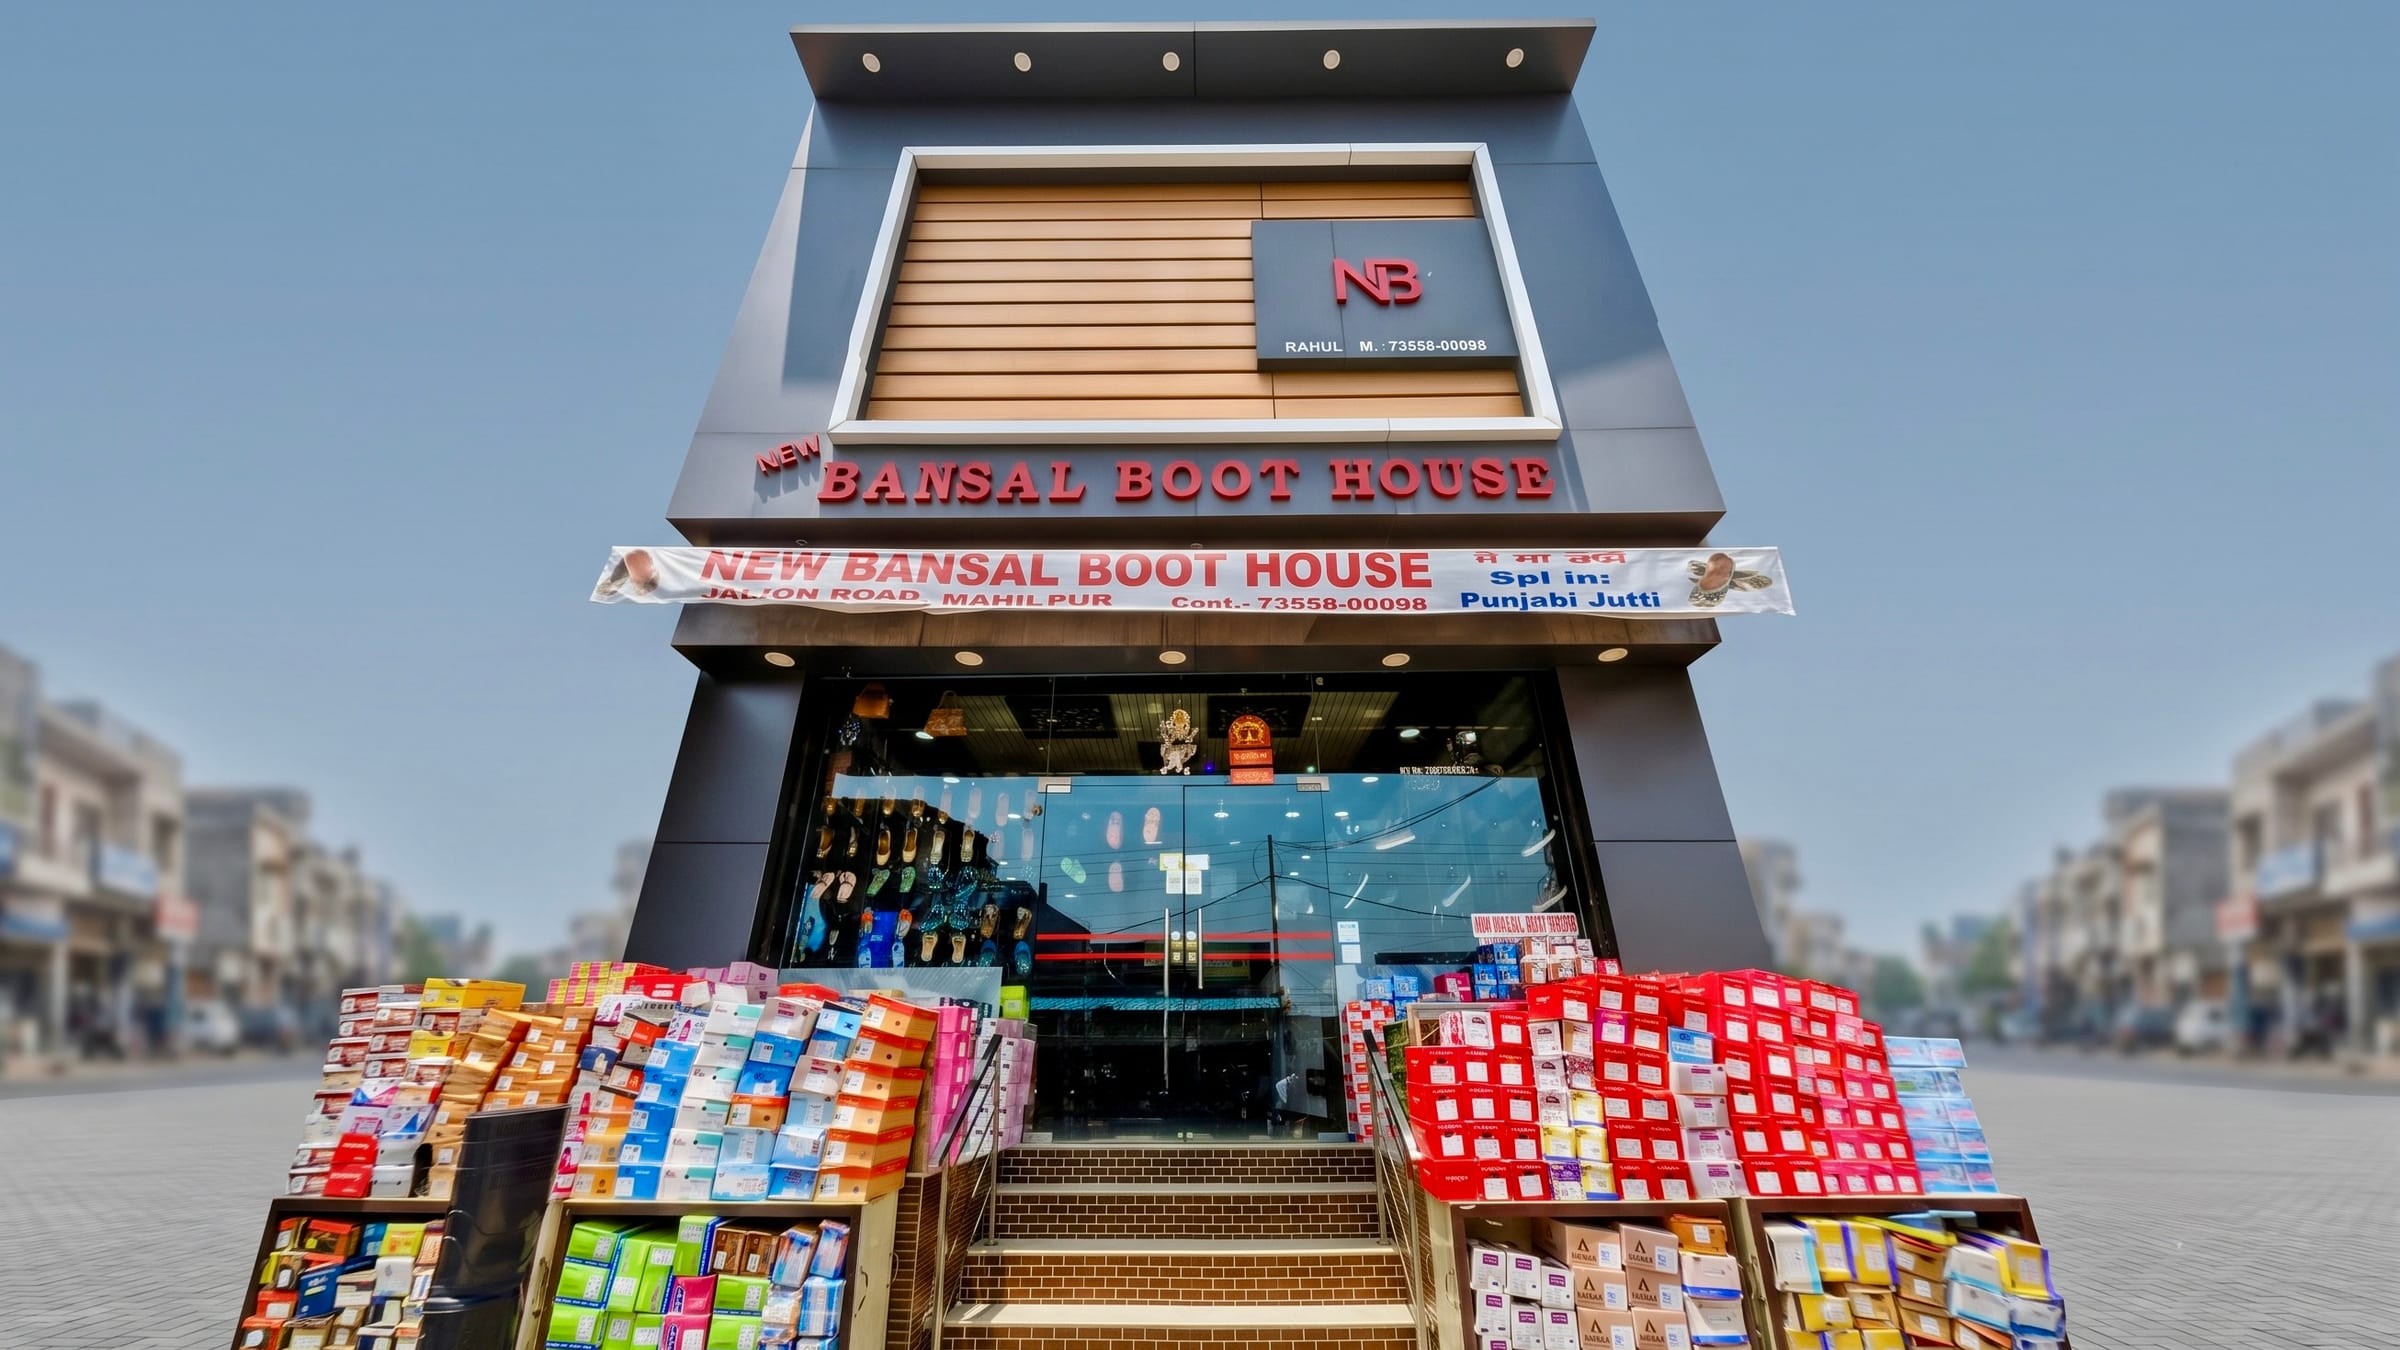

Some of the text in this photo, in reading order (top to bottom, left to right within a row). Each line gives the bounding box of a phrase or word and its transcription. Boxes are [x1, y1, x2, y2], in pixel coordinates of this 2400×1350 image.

[1332, 258, 1423, 305] NB
[1285, 341, 1344, 353] RAHUL
[1388, 339, 1487, 352] 73558-00098
[756, 433, 1555, 503] NEW BANSAL BOOT HOUSE
[700, 550, 1433, 589] NEW BANSAL BOOT HOUSE
[1490, 570, 1611, 588] Spl in:
[830, 588, 920, 601] ROAD
[942, 593, 1113, 607] MAHILPUR
[1257, 596, 1428, 611] 73558-00098
[1460, 591, 1661, 611] Punjabi Jutti
